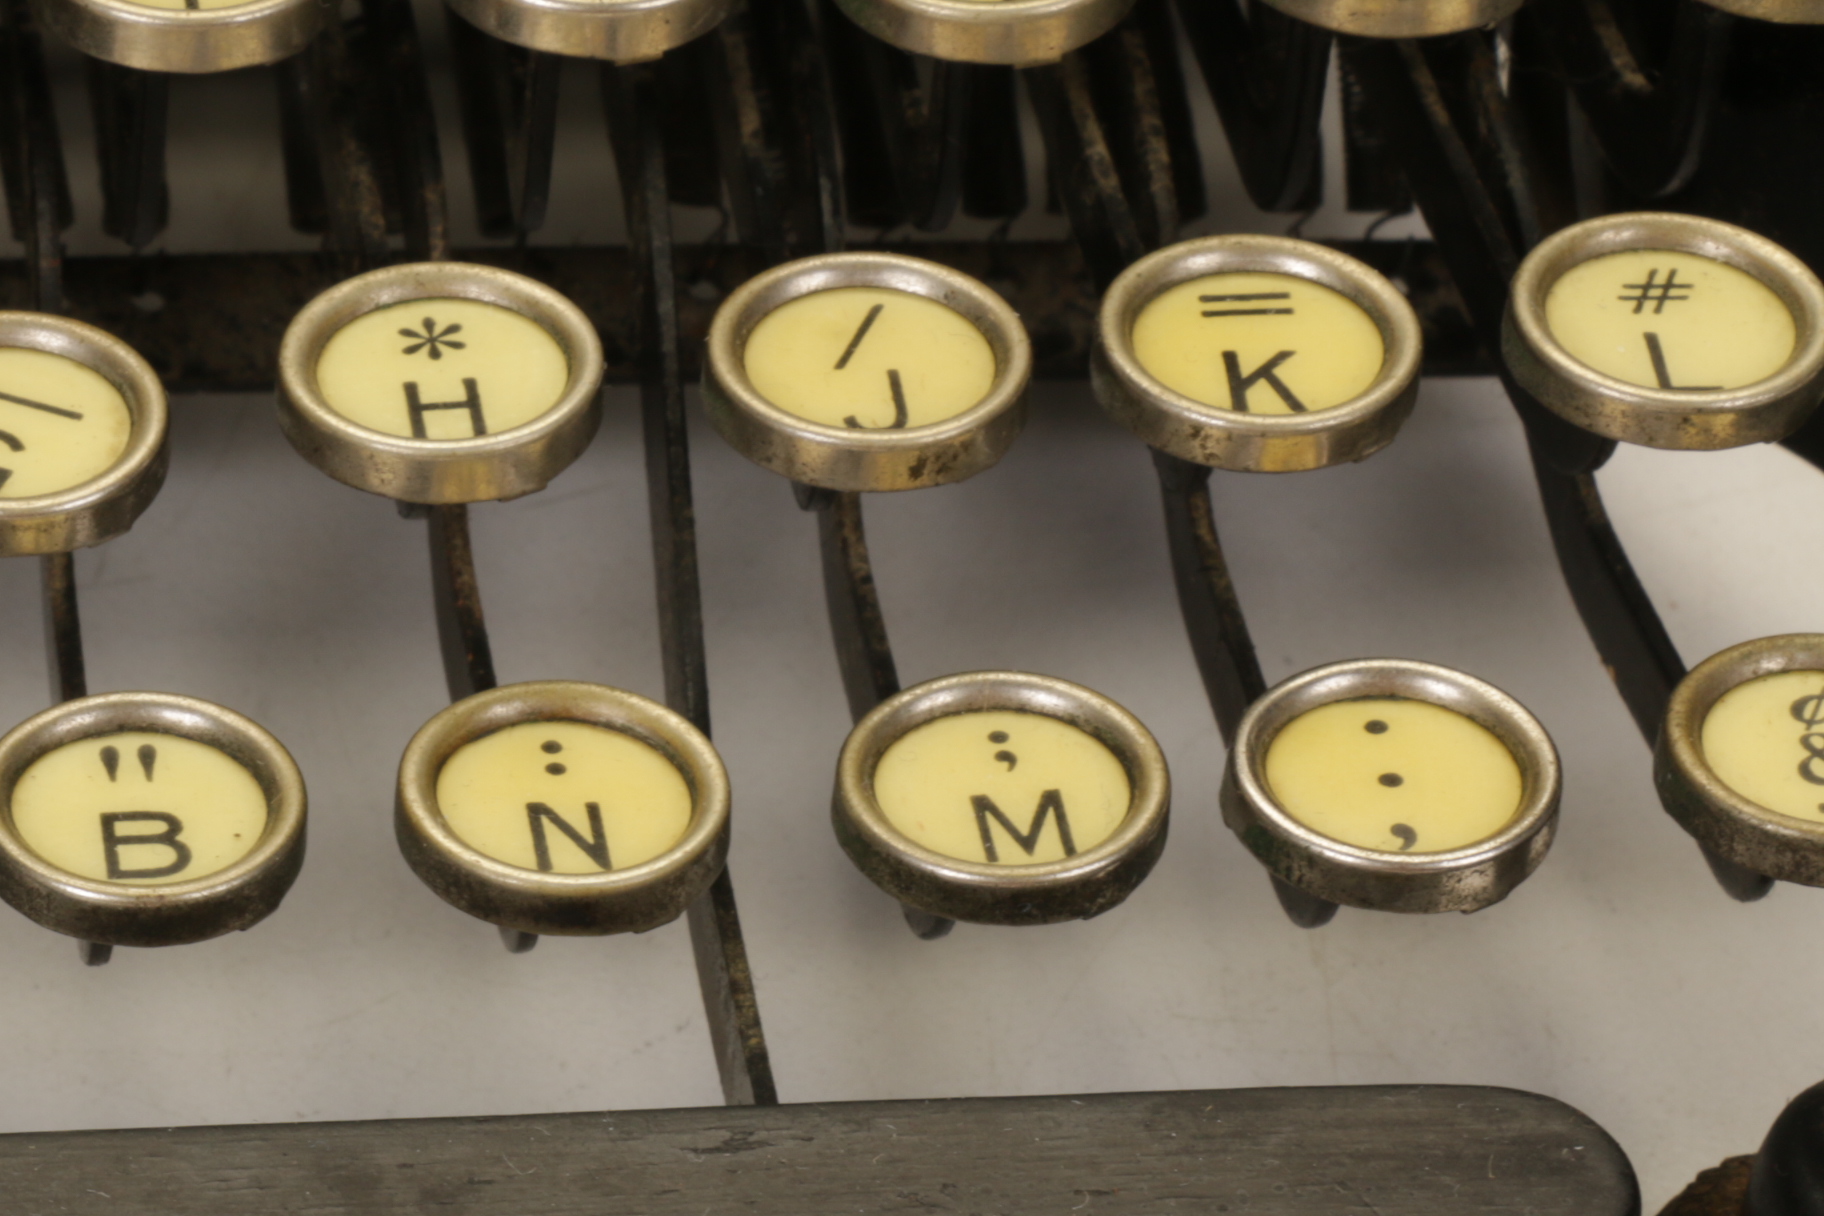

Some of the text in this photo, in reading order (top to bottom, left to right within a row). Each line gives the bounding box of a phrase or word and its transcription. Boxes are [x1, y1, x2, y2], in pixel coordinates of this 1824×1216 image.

[1198, 290, 1294, 319] =
[1617, 268, 1695, 315] #
[1220, 349, 1309, 414] K
[1643, 332, 1724, 391] L
[402, 377, 488, 440] H
[842, 368, 909, 430] J
[99, 810, 193, 881] B
[525, 801, 614, 874] N
[969, 788, 1079, 864] M
